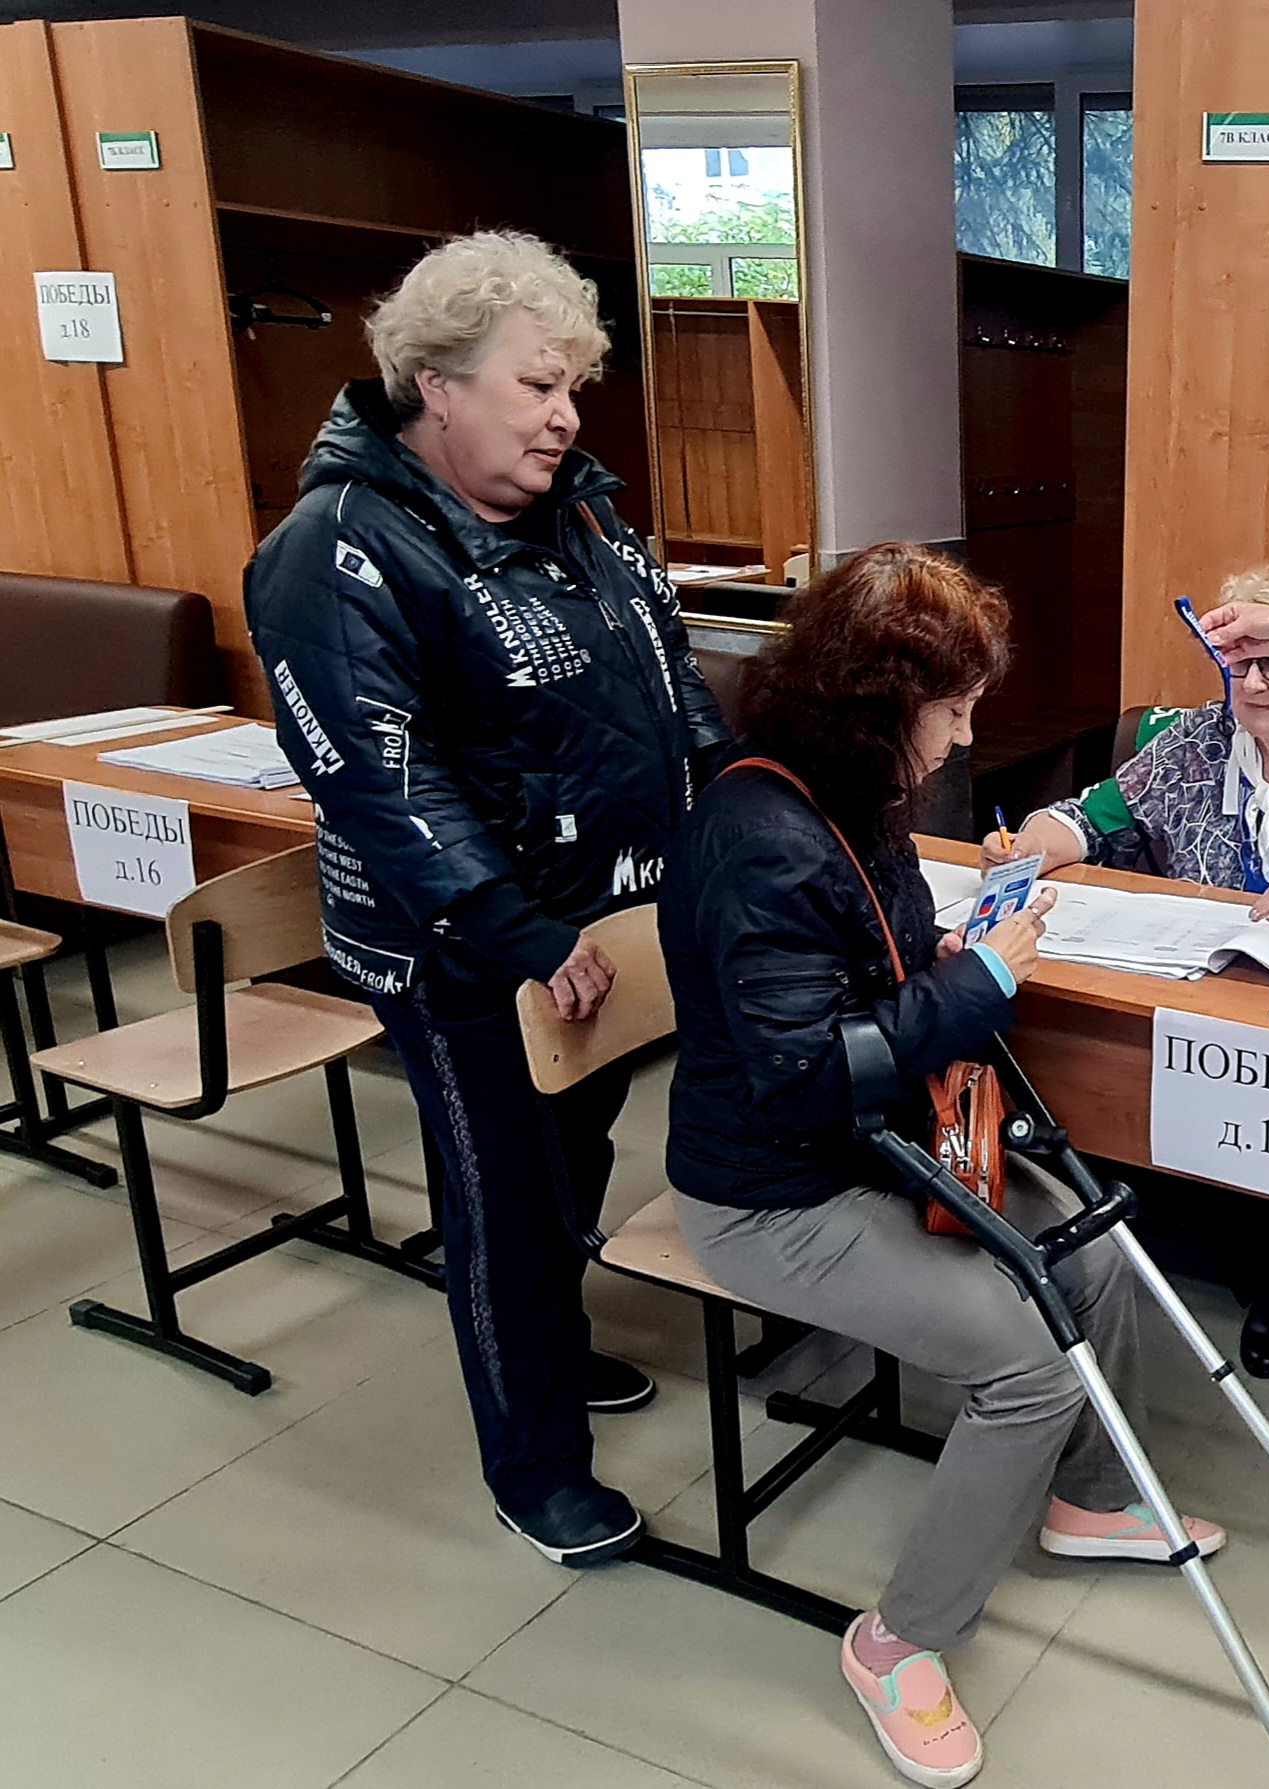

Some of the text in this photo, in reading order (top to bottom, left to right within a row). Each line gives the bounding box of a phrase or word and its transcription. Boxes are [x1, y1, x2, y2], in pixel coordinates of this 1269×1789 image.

[1220, 131, 1234, 144] 7В
[40, 283, 112, 306] ПОБЕДЫ
[463, 573, 537, 687] MKNOLER
[500, 599, 550, 684] TO THE SOUTH
[540, 637, 558, 662] THE
[551, 664, 564, 681] TO
[563, 661, 575, 678] TO
[573, 658, 585, 676] TO
[277, 665, 341, 777] MKNOLER
[370, 713, 405, 770] FRONT
[72, 799, 186, 846] ПОБЕДЫ
[115, 856, 162, 887] д.16
[338, 853, 363, 873] WEST
[360, 969, 404, 995] FRONT
